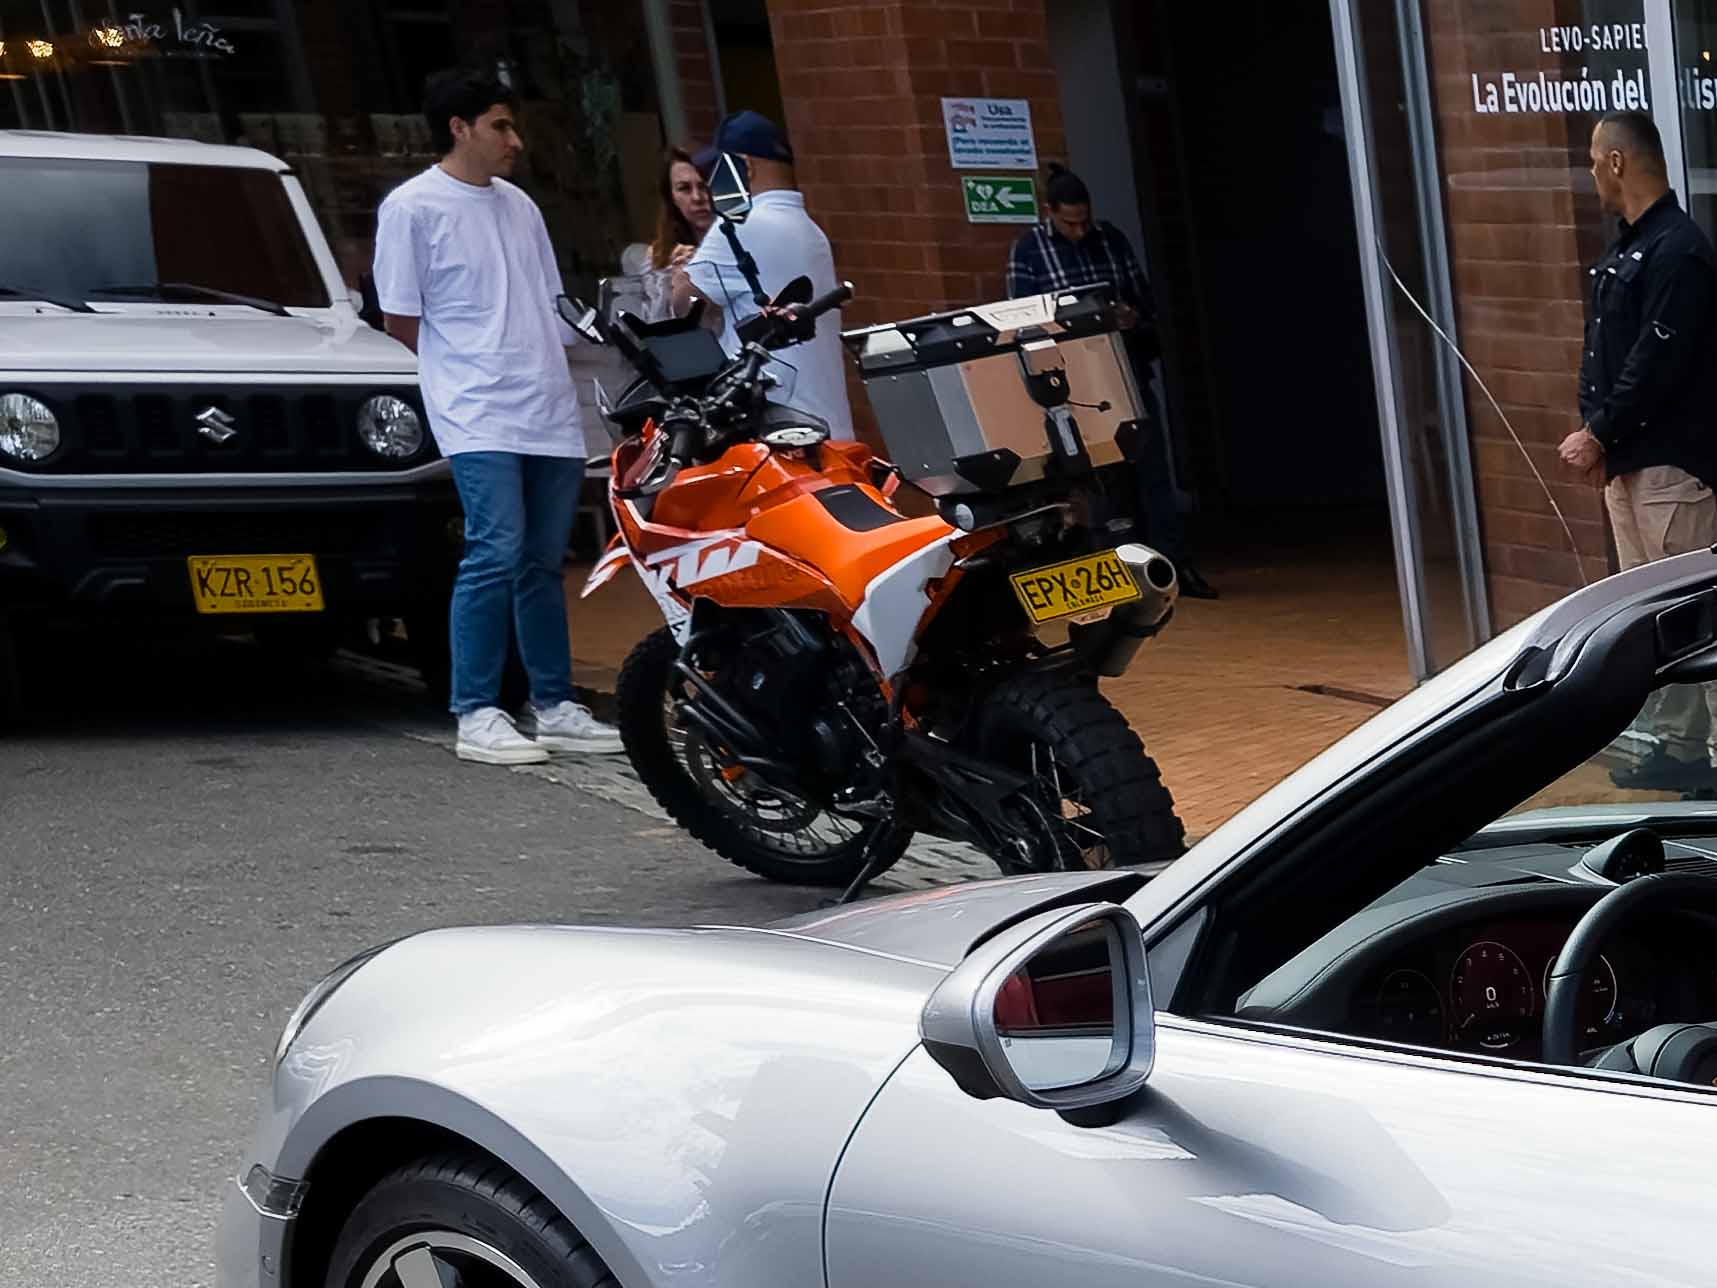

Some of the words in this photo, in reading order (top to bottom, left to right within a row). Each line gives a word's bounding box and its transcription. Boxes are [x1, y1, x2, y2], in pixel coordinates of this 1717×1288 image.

[1540, 23, 1648, 53] LEVO-SAPIE
[1472, 73, 1499, 113] La
[1502, 66, 1606, 112] Evolución
[1612, 69, 1648, 110] del
[971, 201, 999, 212] DEA
[196, 566, 255, 598] KZR
[261, 566, 316, 596] 156
[1021, 572, 1078, 610] EPX
[1075, 558, 1131, 596] 26H
